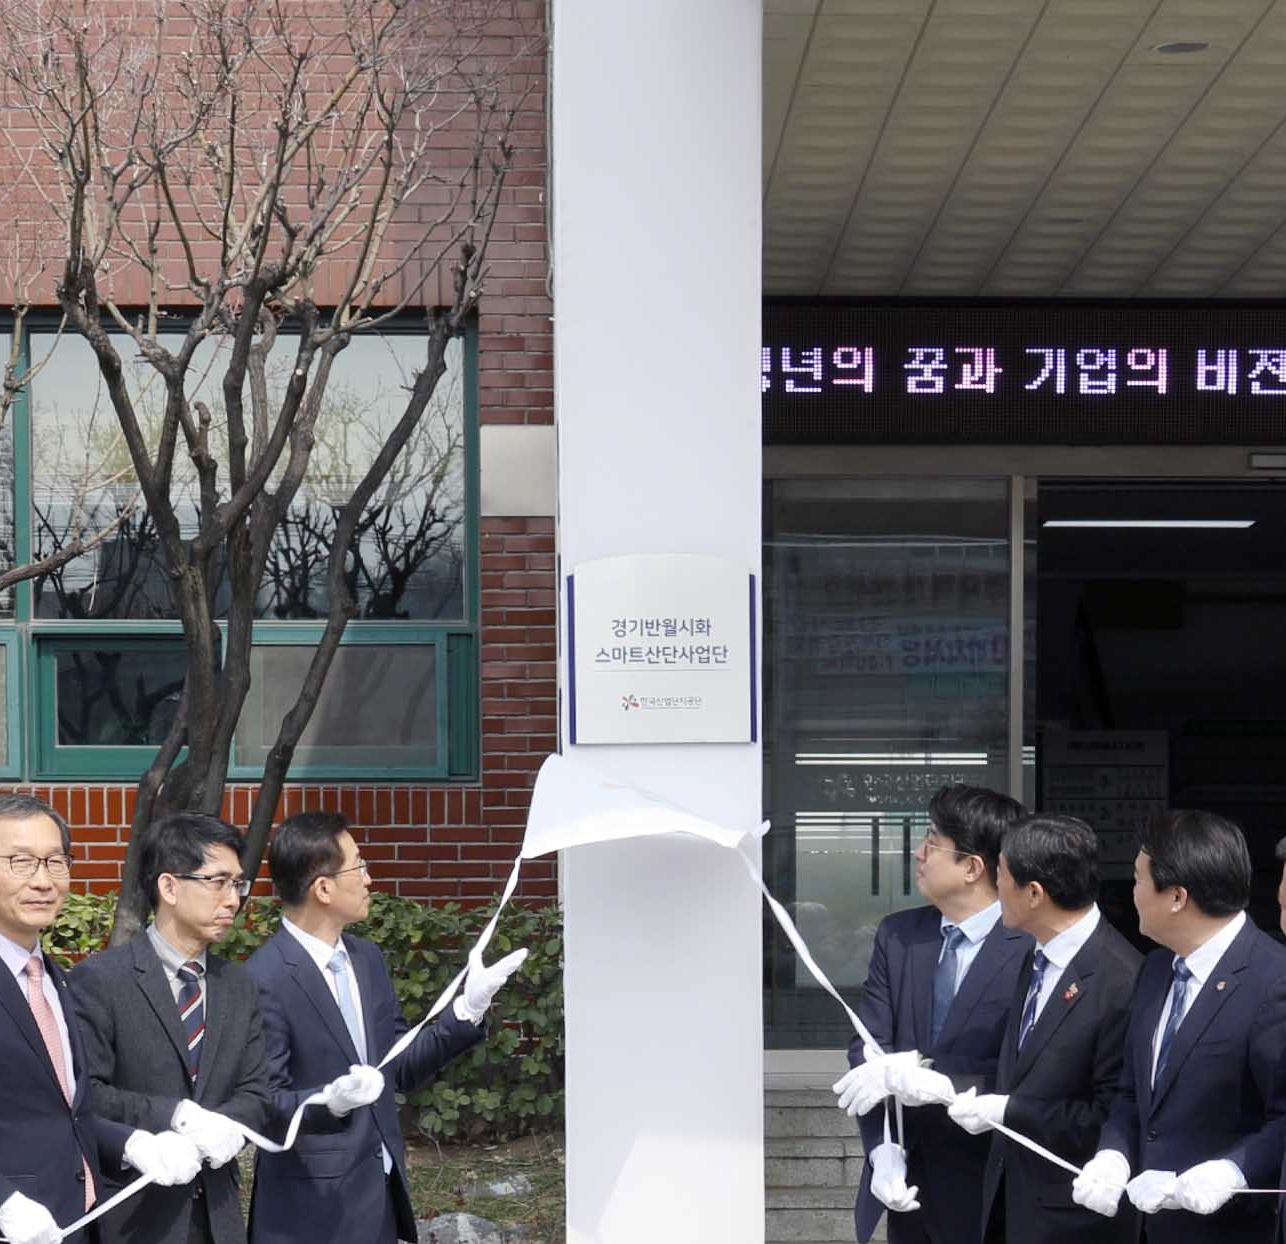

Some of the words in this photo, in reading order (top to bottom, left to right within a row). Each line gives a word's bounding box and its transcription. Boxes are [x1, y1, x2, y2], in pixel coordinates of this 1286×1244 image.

[762, 347, 873, 392] 년의
[904, 347, 1003, 393] 꿈과
[1025, 348, 1167, 394] 기업의
[611, 618, 712, 638] 경기반월시화
[594, 645, 729, 665] 스마트산단사업단
